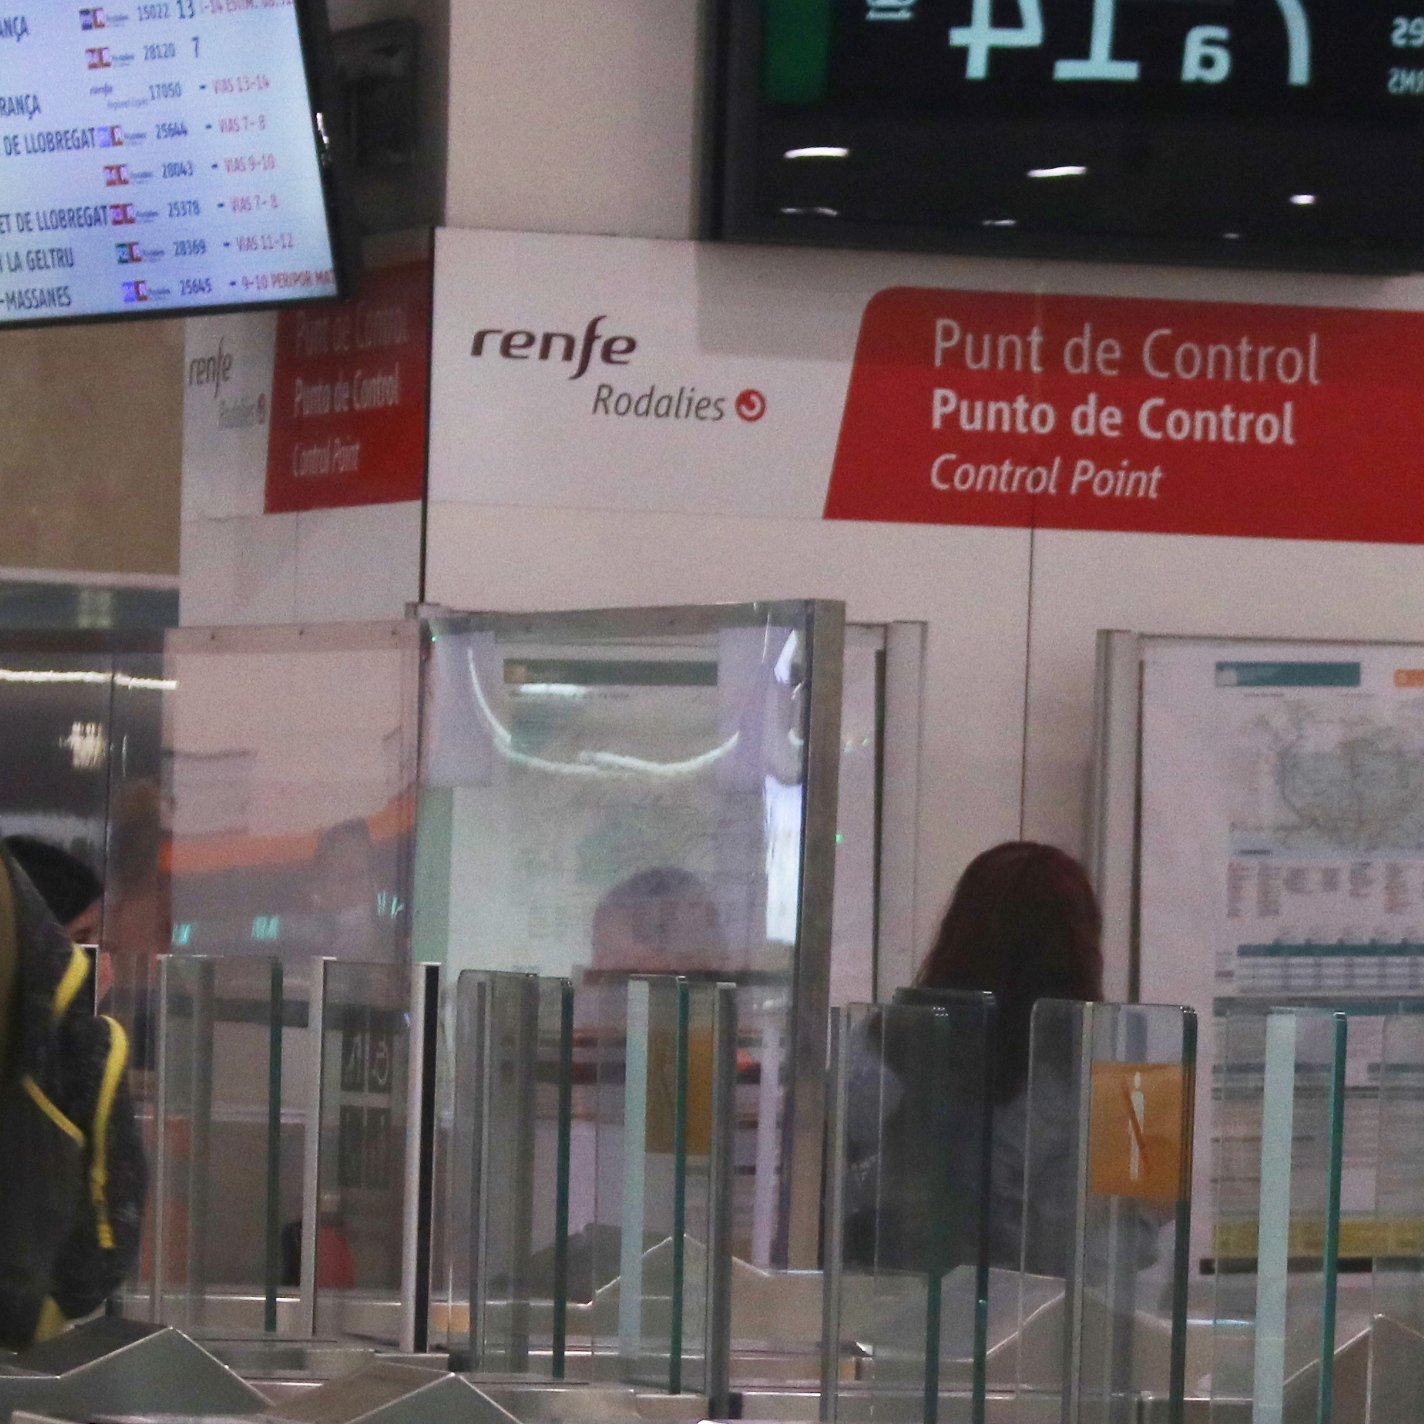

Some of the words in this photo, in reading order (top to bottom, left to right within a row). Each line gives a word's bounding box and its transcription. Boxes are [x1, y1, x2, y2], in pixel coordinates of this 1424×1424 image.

[191, 36, 200, 58] 7
[3, 134, 21, 156] DE
[25, 127, 97, 154] LLOBREGAT
[16, 212, 33, 233] DE
[37, 204, 109, 232] LLOBREGAT
[6, 250, 24, 273] LA
[188, 336, 233, 399] renfe
[471, 315, 638, 380] renfe
[933, 318, 1044, 374] Punt
[1062, 322, 1123, 377] de
[1141, 327, 1321, 387] Control
[591, 382, 727, 423] Rodalies
[932, 388, 1057, 435] Punto
[1070, 392, 1124, 438] de
[1137, 396, 1295, 446] Control
[929, 452, 1060, 495] Control
[1069, 458, 1164, 500] Point
